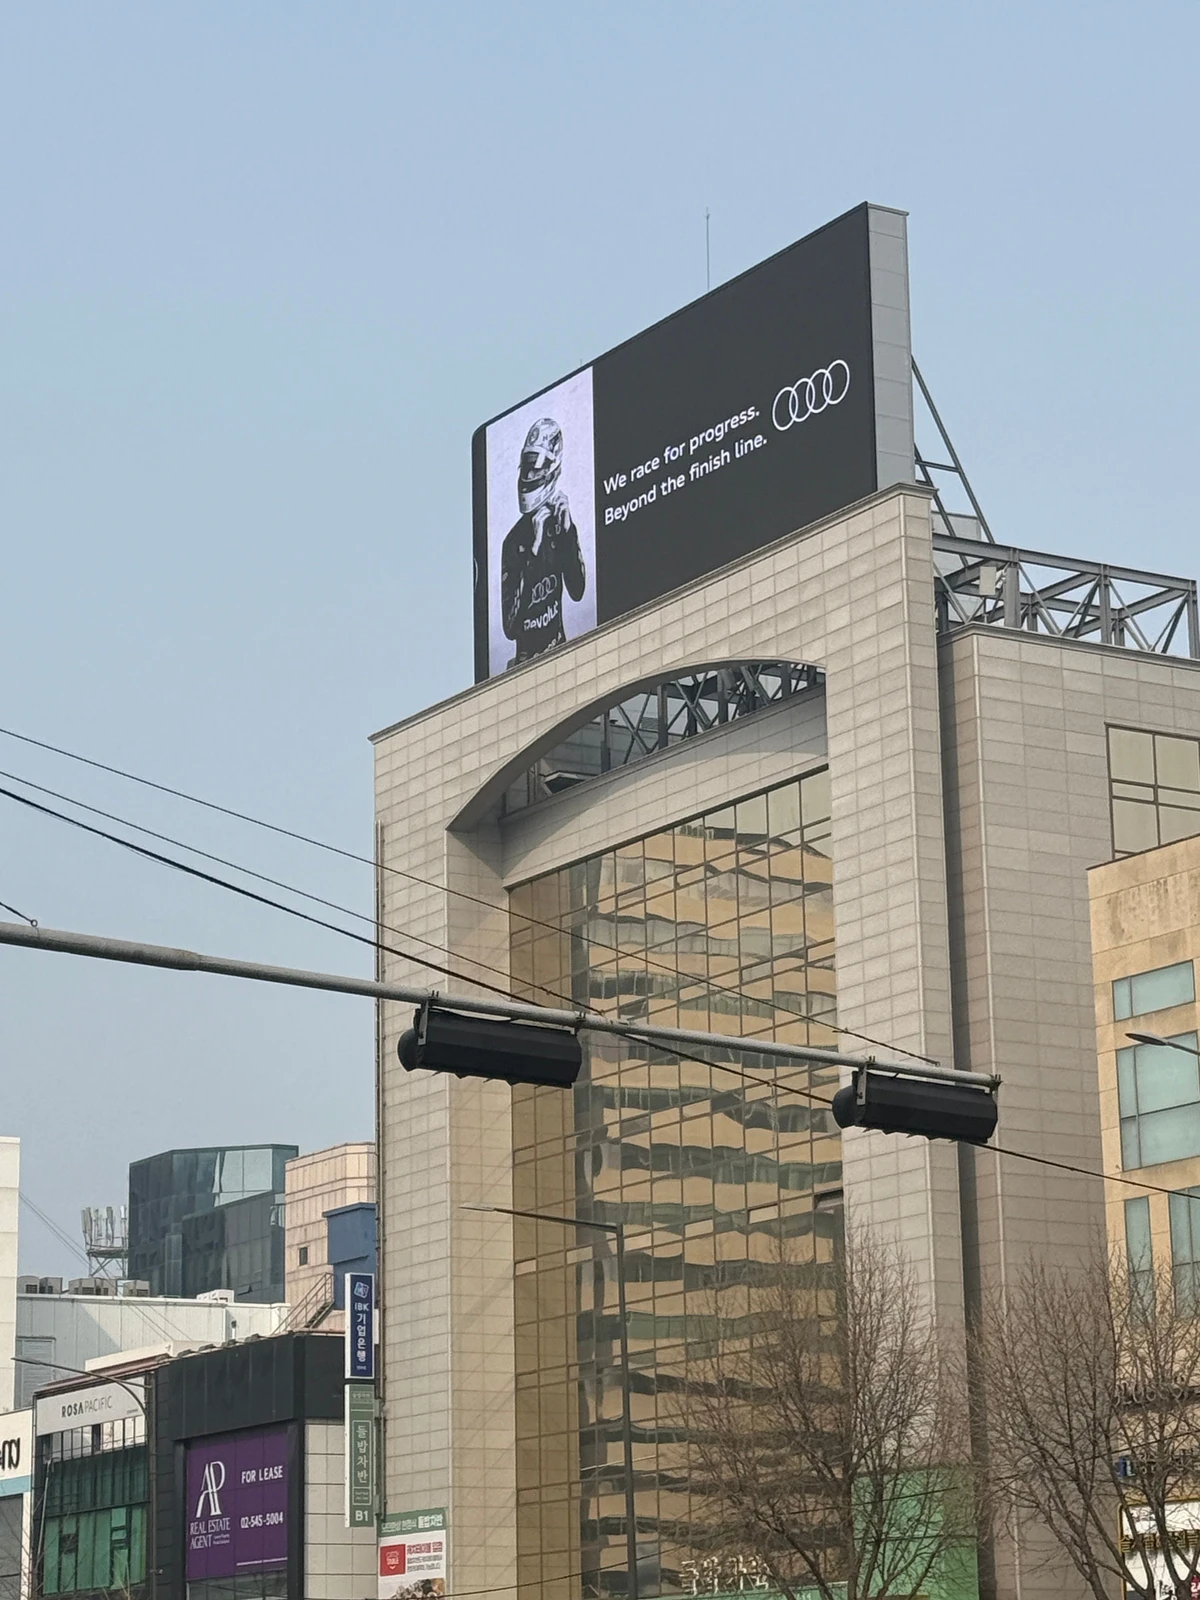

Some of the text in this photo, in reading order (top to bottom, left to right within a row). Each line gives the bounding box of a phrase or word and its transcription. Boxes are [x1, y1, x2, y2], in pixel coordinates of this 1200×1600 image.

[603, 405, 760, 495] We race for progress.
[604, 433, 768, 526] Beyond the finish line.
[354, 1302, 369, 1311] IBK
[356, 1313, 367, 1362] 기업은행
[241, 1465, 284, 1484] FOR LEASE
[240, 1511, 284, 1529] 02-545-5004
[355, 1510, 369, 1521] B1
[190, 1517, 231, 1536] REAL ESTATE
[190, 1534, 212, 1550] AGENT
